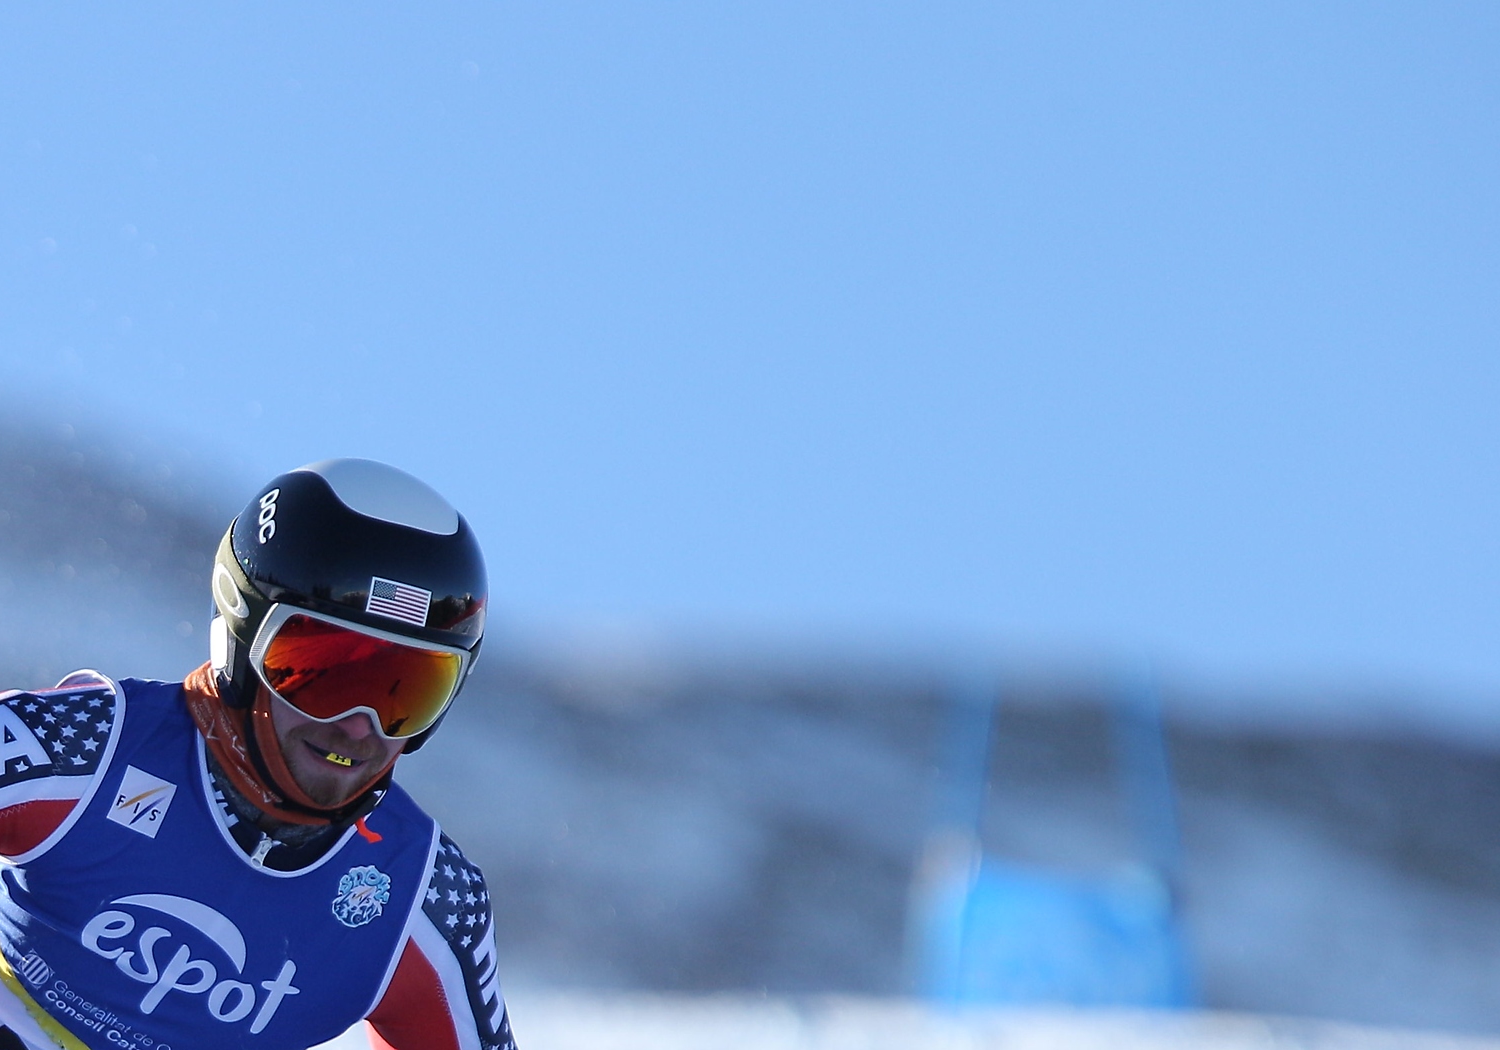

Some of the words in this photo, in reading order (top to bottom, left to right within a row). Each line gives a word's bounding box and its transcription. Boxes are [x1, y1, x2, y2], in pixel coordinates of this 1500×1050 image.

[116, 794, 159, 821] FIS
[81, 909, 301, 1035] espot
[45, 989, 106, 1033] Consell
[54, 979, 132, 1034] Generalitat
[133, 1030, 154, 1047] de
